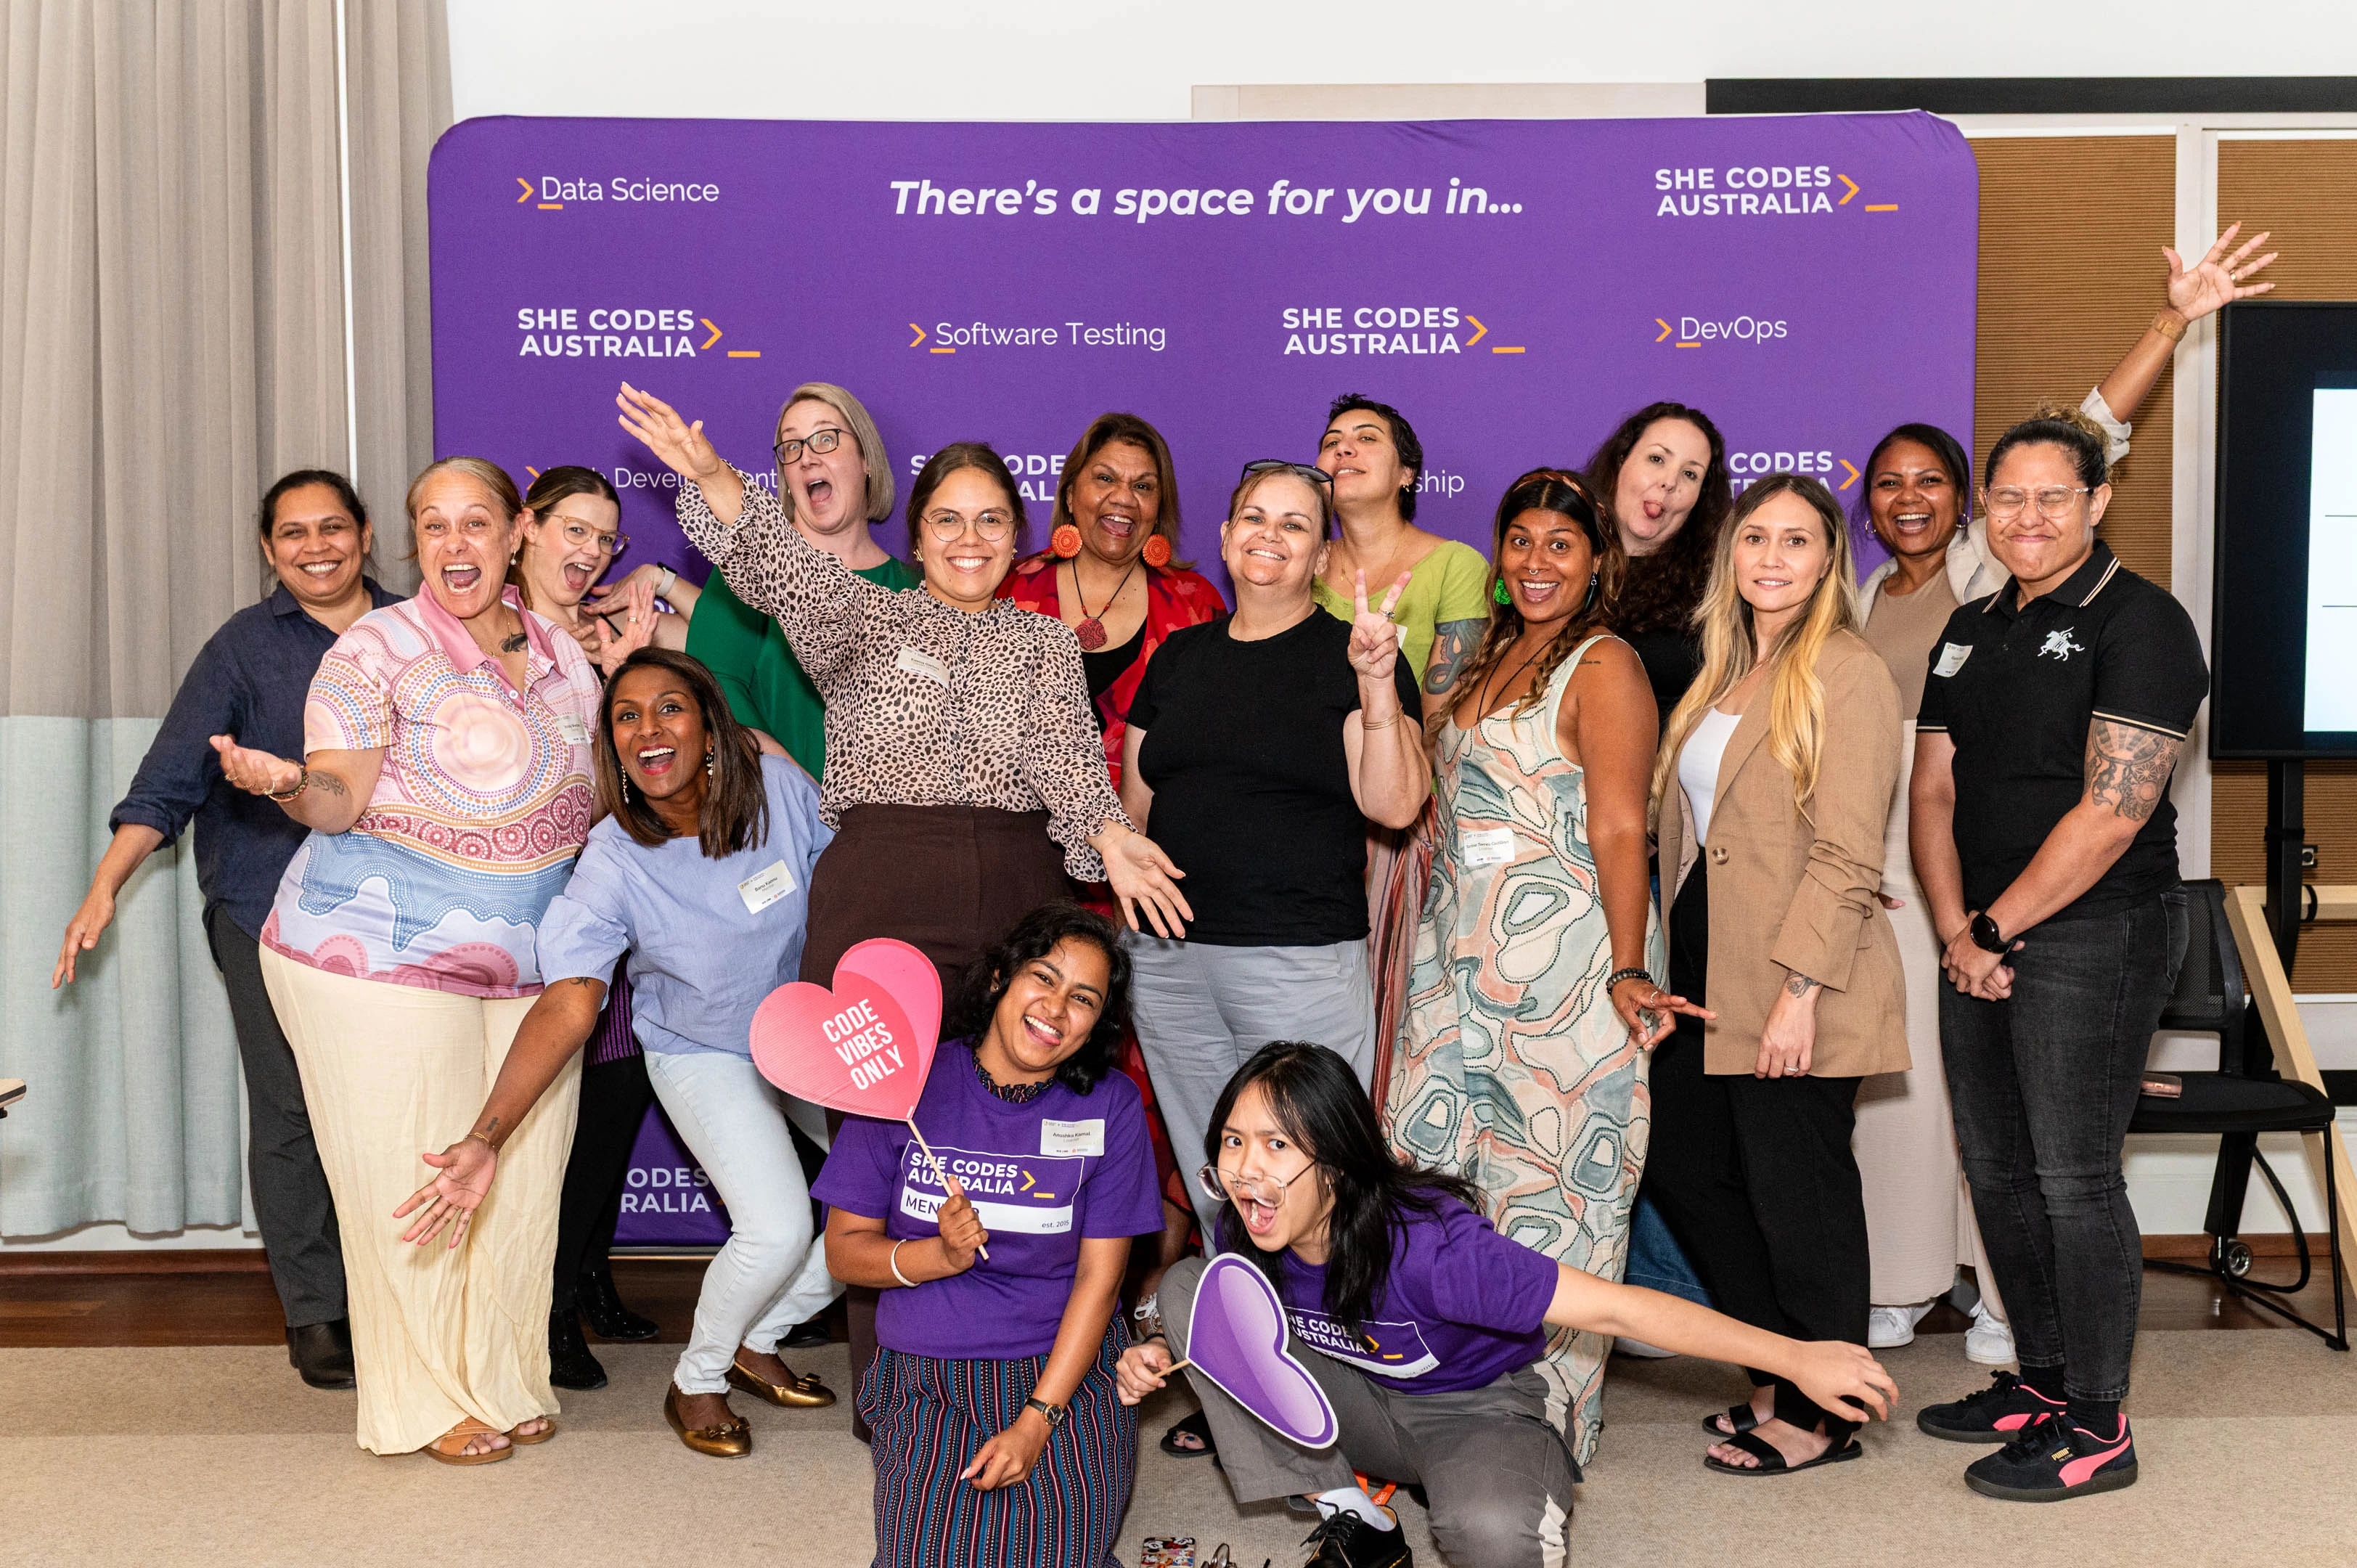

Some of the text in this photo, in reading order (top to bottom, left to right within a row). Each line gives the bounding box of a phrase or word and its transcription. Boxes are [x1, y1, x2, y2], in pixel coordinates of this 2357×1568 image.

[542, 176, 720, 203] Data Science
[1654, 165, 1831, 191] SHE CODES
[1071, 188, 1102, 216] a
[1113, 188, 1254, 224] space
[1267, 179, 1335, 216] for
[1341, 187, 1432, 224] you
[1657, 191, 1834, 217] AUSTRALIA
[518, 308, 695, 331] SHE CODES
[1283, 306, 1460, 330] SHE CODES
[1680, 315, 1788, 345] DevOps
[519, 334, 697, 358] AUSTRALIA
[936, 321, 1166, 352] Software Testing
[1283, 332, 1461, 355] AUSTRALIA
[1004, 454, 1066, 475] ODE
[1728, 451, 1833, 474] CODES
[822, 998, 879, 1043] CODE
[834, 1021, 894, 1066] VIBES
[849, 1045, 904, 1090] ONLY
[626, 1167, 710, 1188] ODES
[952, 1159, 1018, 1178] CODES
[621, 1192, 711, 1213] RALIA
[1291, 1325, 1368, 1355] USTRALIA
[2051, 1447, 2070, 1461] PUMA
